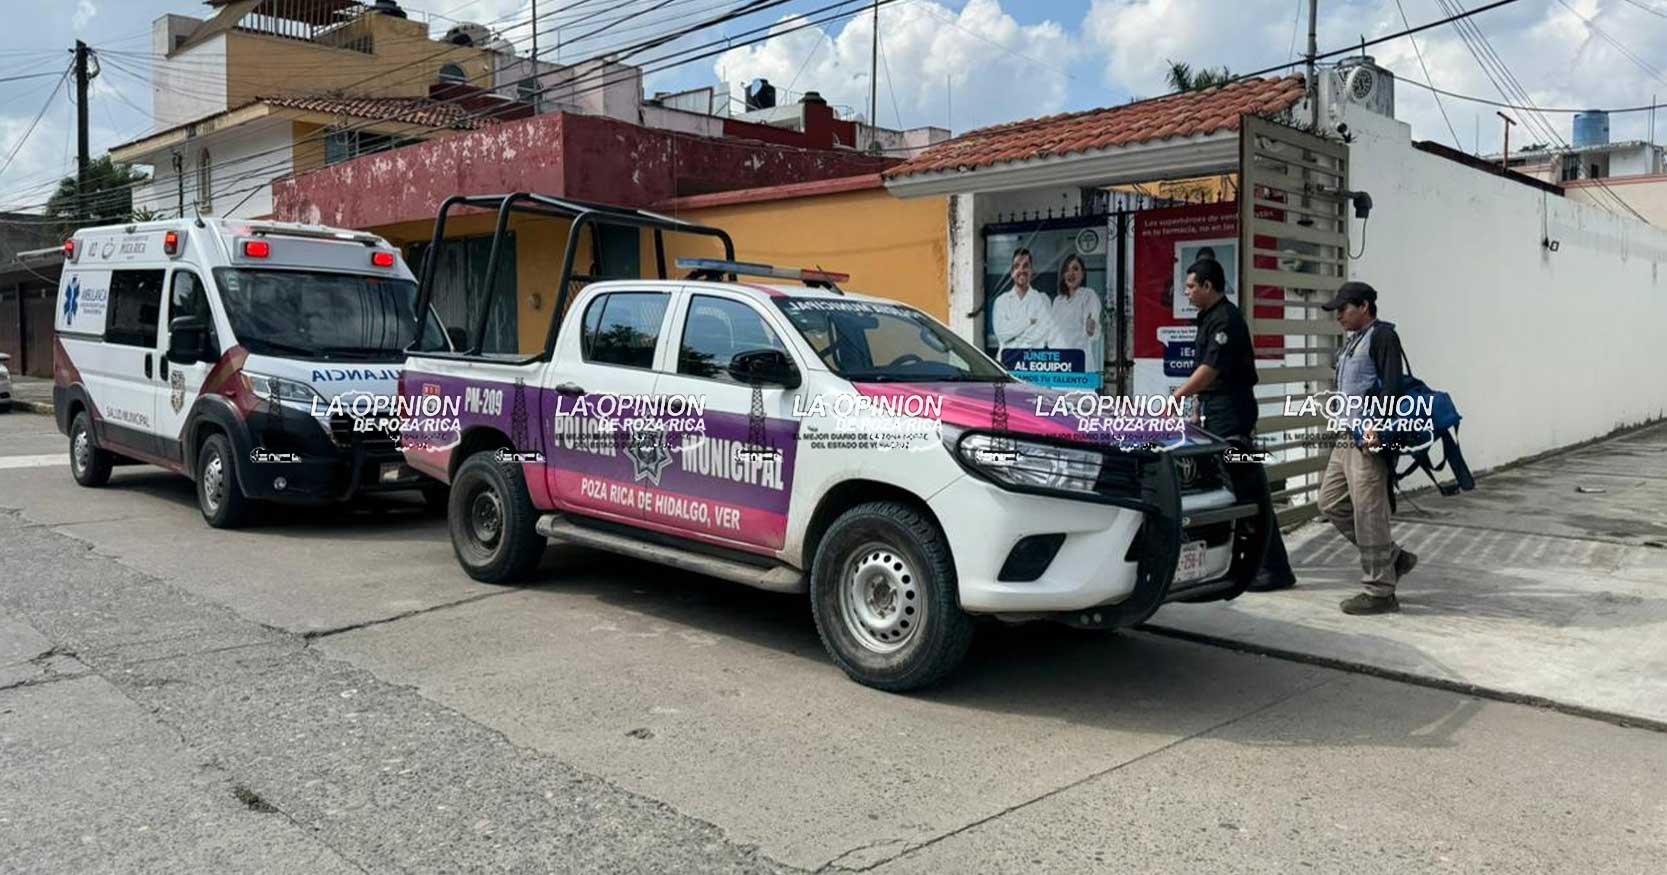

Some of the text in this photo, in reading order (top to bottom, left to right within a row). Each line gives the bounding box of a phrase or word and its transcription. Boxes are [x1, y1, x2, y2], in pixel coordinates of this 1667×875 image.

[1014, 362, 1072, 372] AL EQUIPO!
[1169, 360, 1194, 369] cont
[1053, 376, 1088, 384] TALENTO
[465, 387, 503, 416] PM-209
[682, 434, 784, 491] MUNICIPAL
[581, 479, 741, 530] POZA RICA DE HIDALGO, VER
